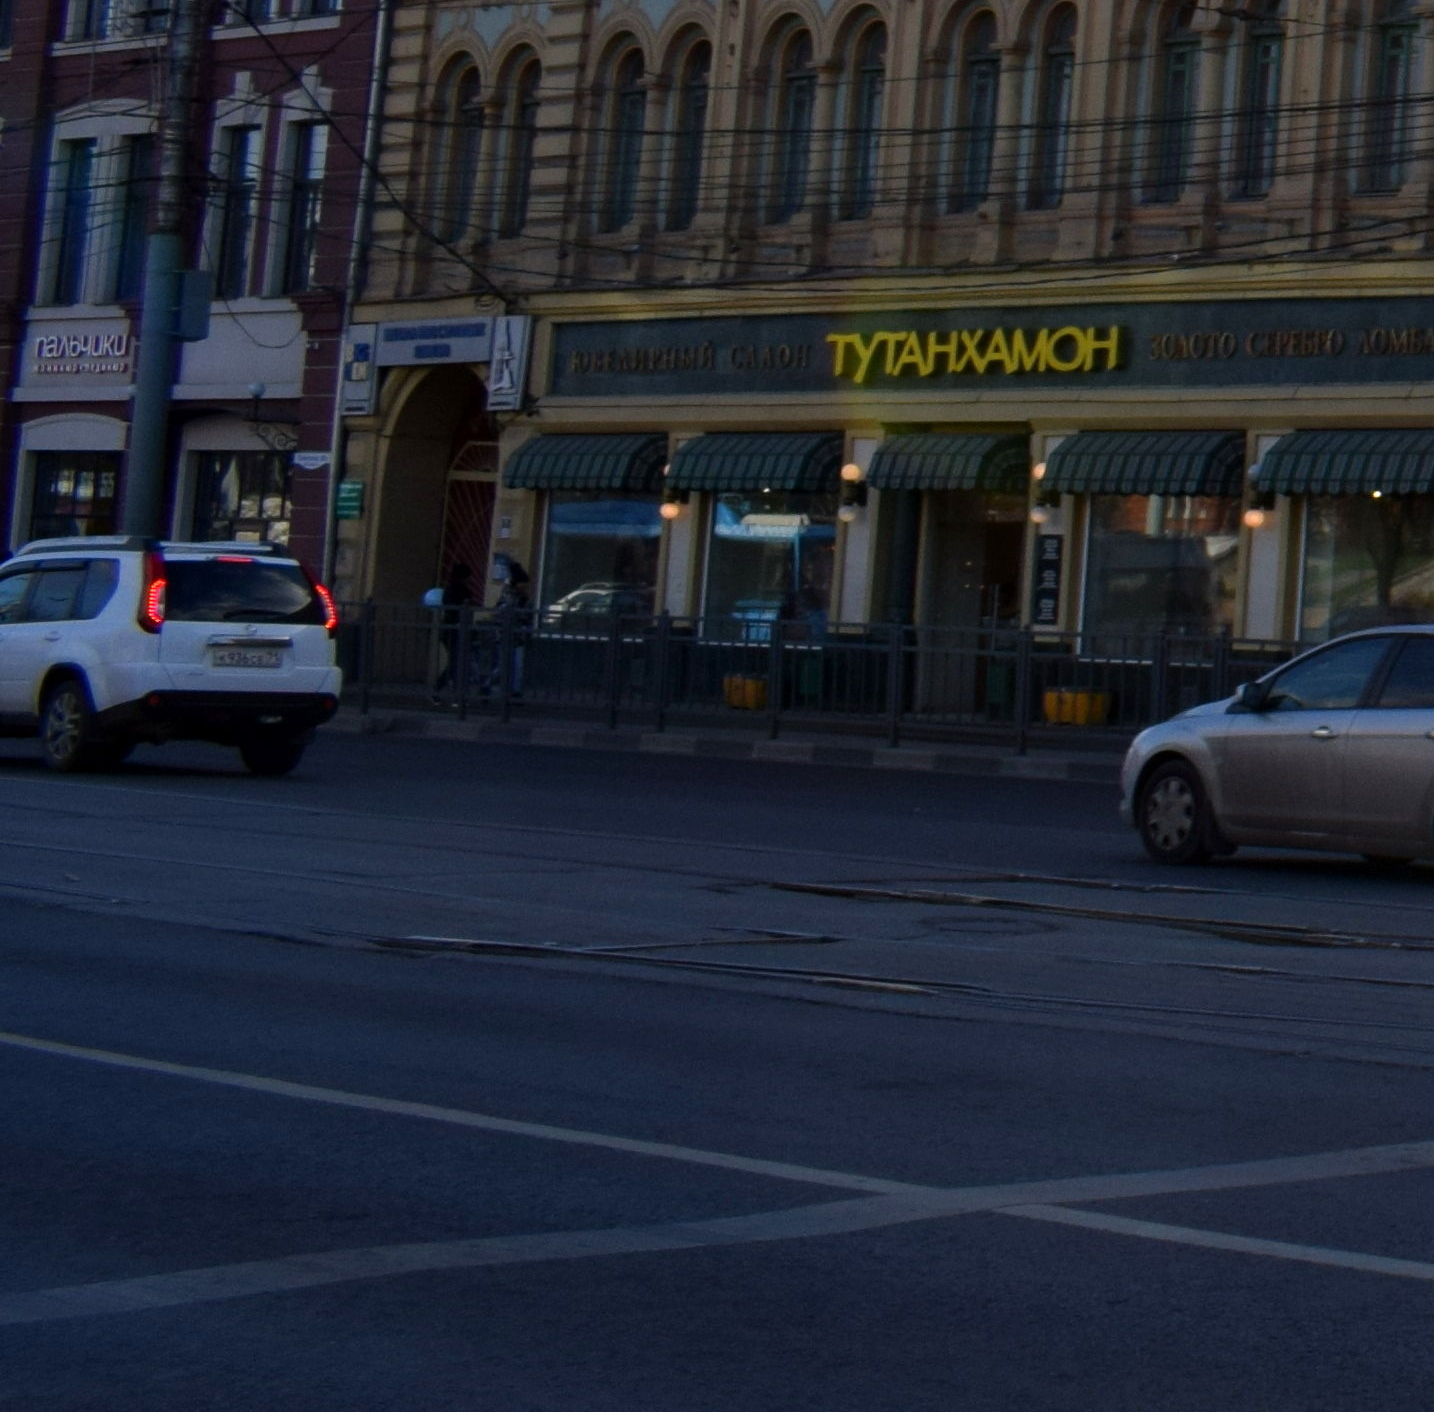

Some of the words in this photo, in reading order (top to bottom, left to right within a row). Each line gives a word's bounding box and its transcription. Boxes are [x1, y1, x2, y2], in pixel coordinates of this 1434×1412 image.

[36, 335, 127, 359] пальчики
[571, 342, 716, 374] ЮВЕЛИРНЫЙ
[731, 344, 813, 372] САЛОН
[825, 325, 1119, 385] ТУТАНХАМОН
[1150, 331, 1238, 361] ЗОЛОТО
[1245, 329, 1346, 358] СЕРЕБРО
